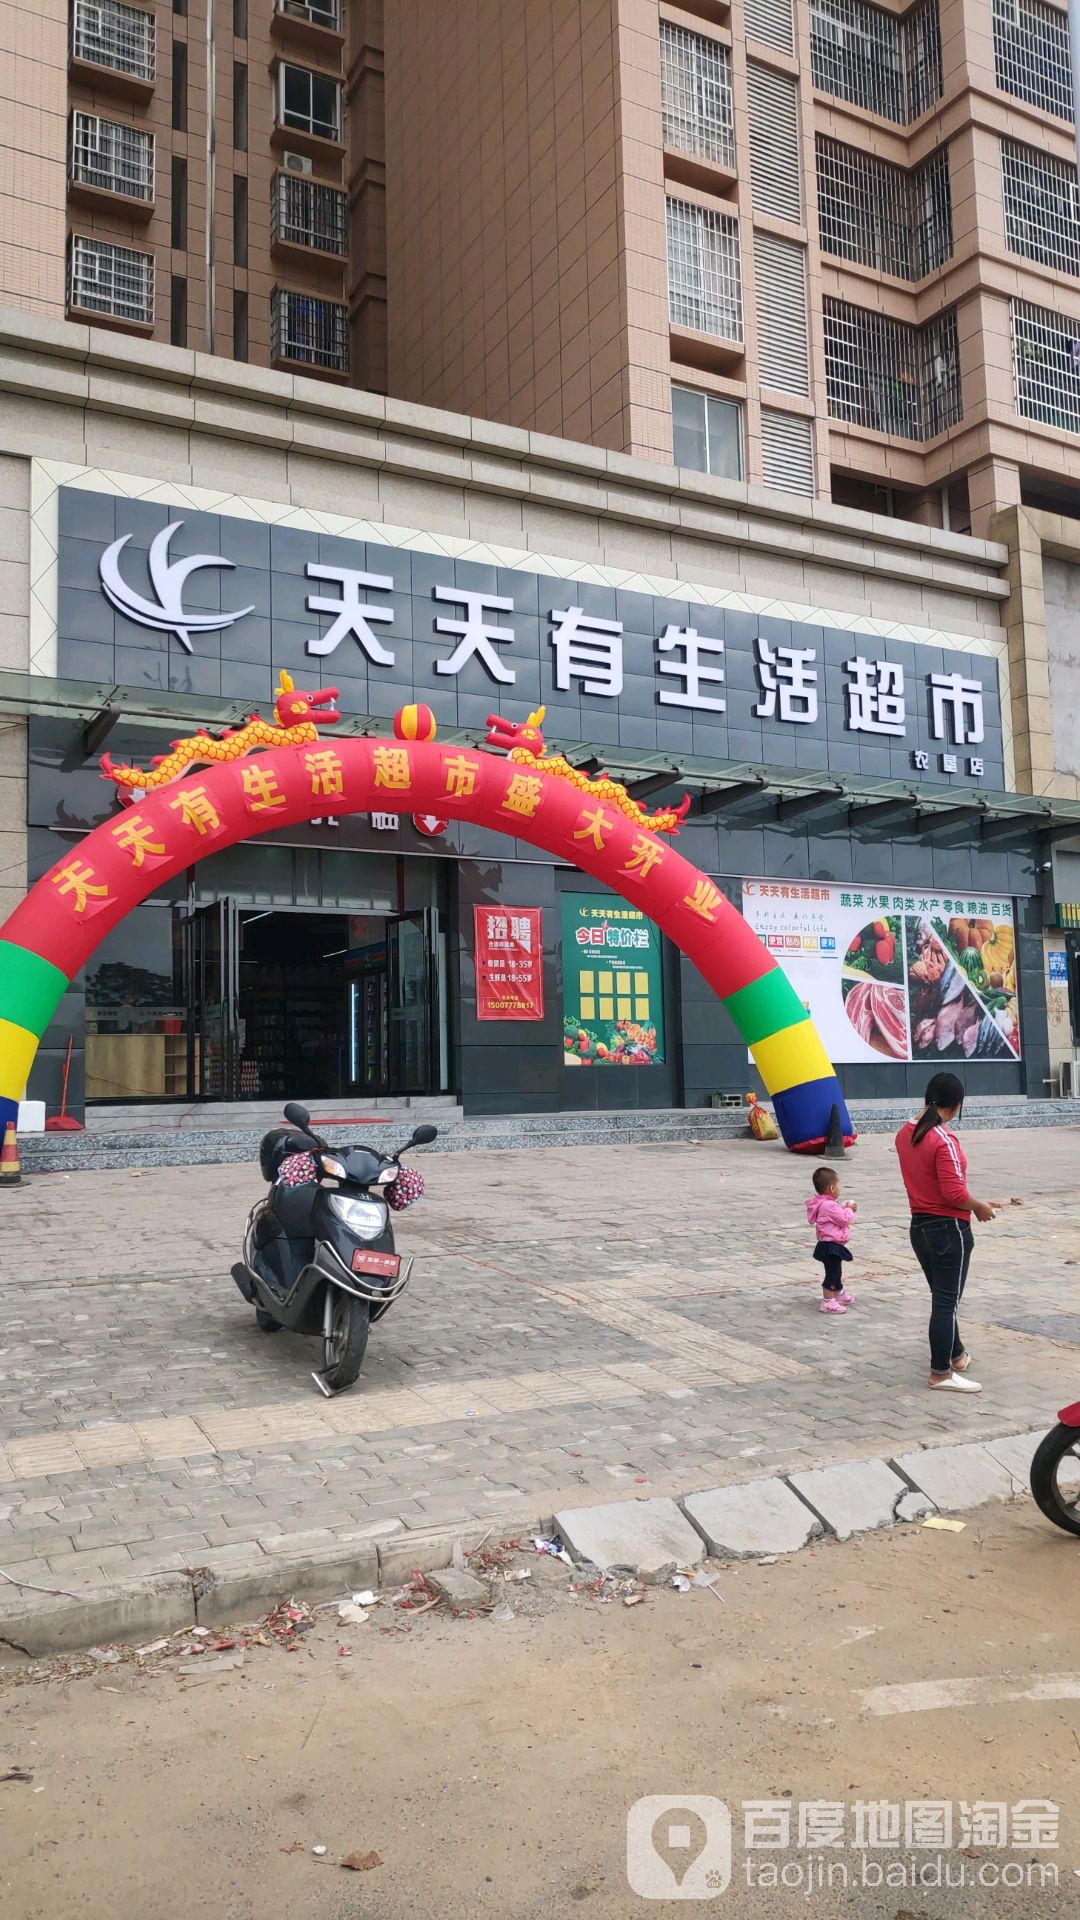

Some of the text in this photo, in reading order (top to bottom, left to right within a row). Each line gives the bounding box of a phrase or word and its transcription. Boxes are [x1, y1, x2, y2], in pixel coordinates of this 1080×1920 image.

[306, 562, 984, 745] 天天有生活超市
[914, 750, 984, 776] 农垦店
[51, 746, 724, 922] 天天有生活超市盛大开业
[759, 885, 830, 900] 天天有生活超市
[840, 893, 1012, 917] 蔬菜 水果 肉类 水产 零食 粮油 百货
[591, 909, 644, 919] 天天有生活超市
[487, 915, 531, 954] 招聘
[576, 927, 649, 948] 今日特价栏
